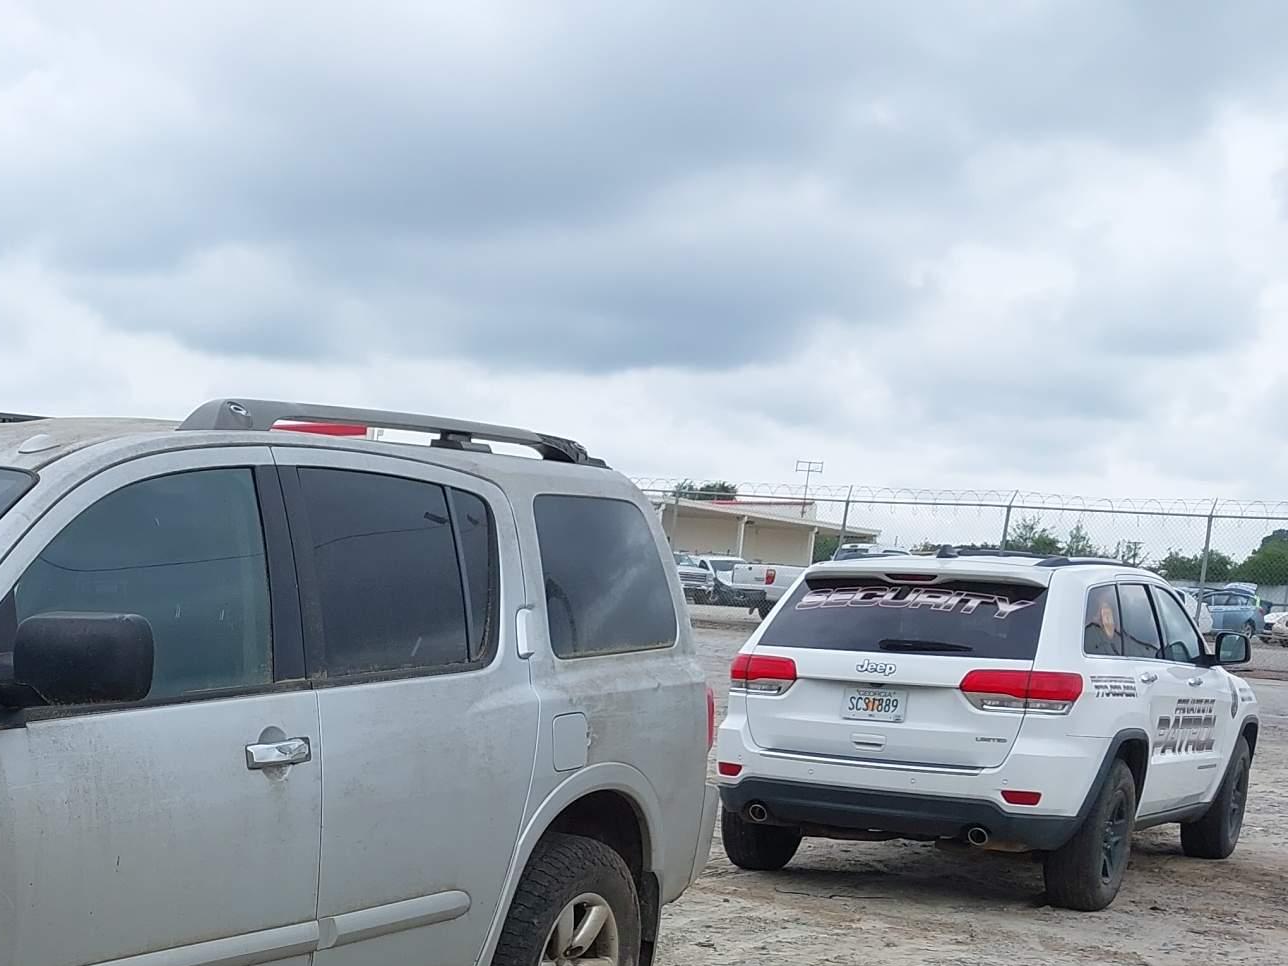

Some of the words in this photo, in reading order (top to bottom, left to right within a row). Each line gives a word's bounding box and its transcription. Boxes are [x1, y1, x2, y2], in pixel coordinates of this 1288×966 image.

[796, 587, 1035, 619] SECURITY
[856, 659, 897, 676] Jeep
[1153, 715, 1216, 756] PATROL
